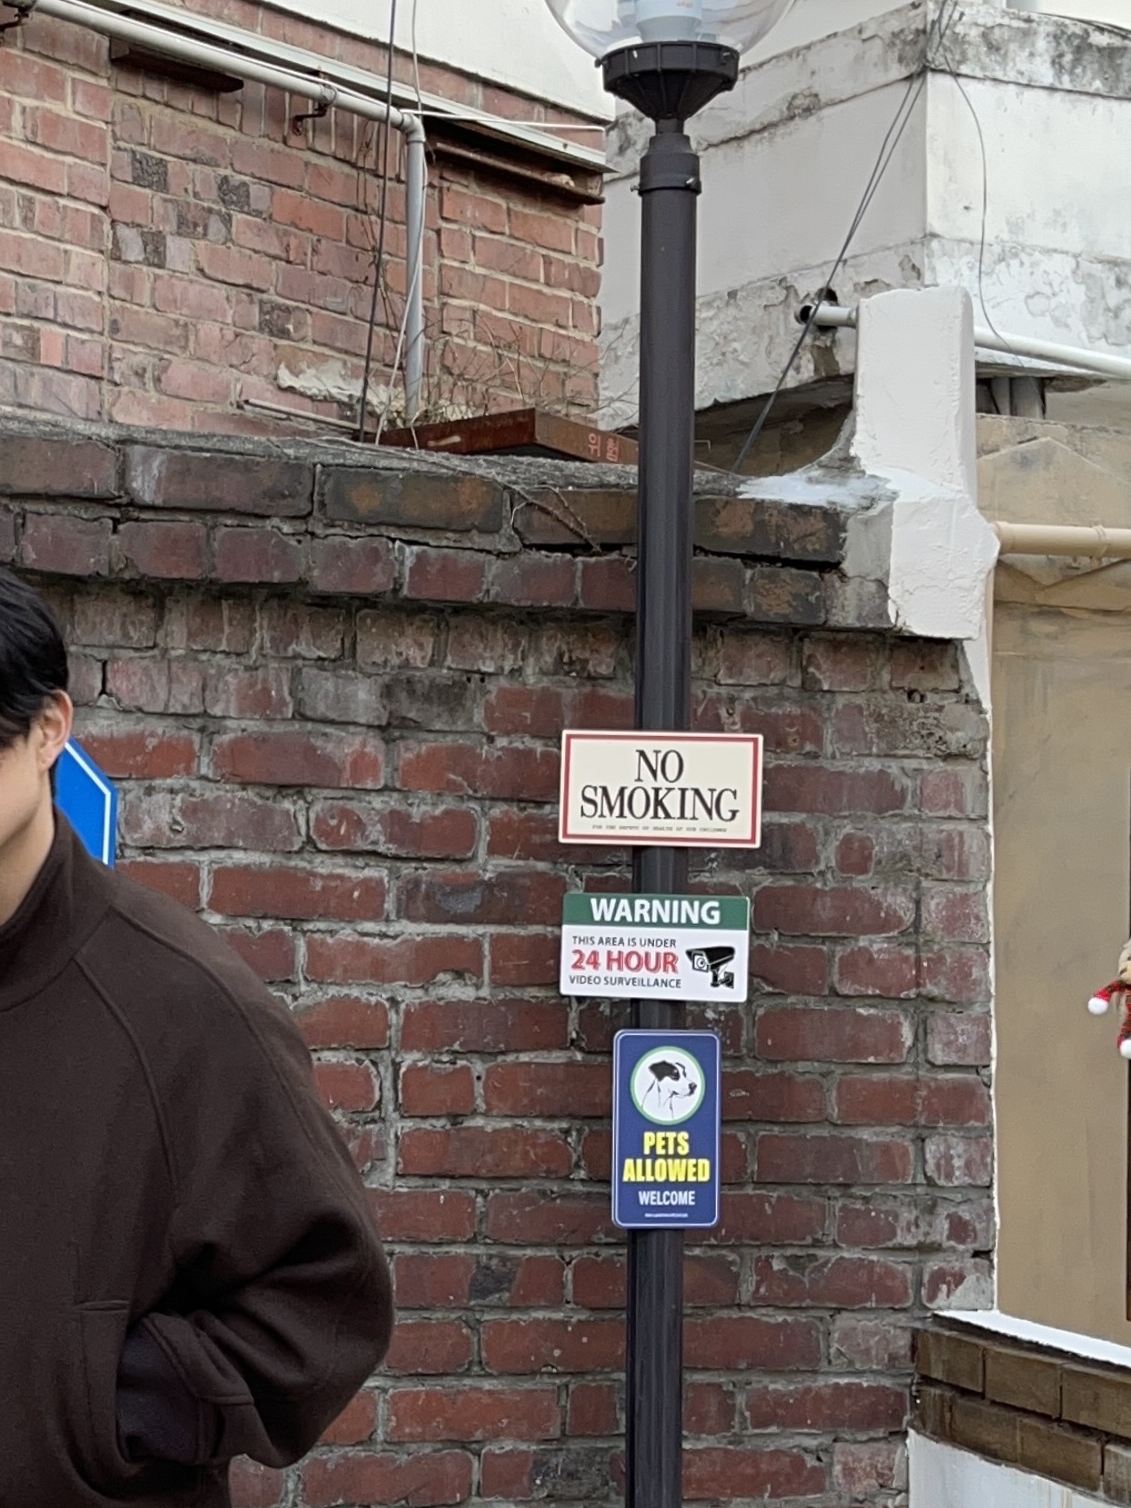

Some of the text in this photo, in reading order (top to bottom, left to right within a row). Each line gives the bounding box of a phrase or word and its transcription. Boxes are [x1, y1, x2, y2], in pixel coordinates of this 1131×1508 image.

[634, 749, 684, 783] NO
[580, 785, 740, 822] SMOKING
[590, 898, 720, 925] WARNING
[572, 936, 677, 948] THIS AREA IS UNDER
[571, 949, 679, 974] 24 HOUR
[569, 975, 681, 988] VIDEO SURVEILLANCE
[643, 1131, 690, 1155] PETS
[622, 1158, 711, 1182] ALLOWED
[638, 1190, 696, 1205] WELCOME
